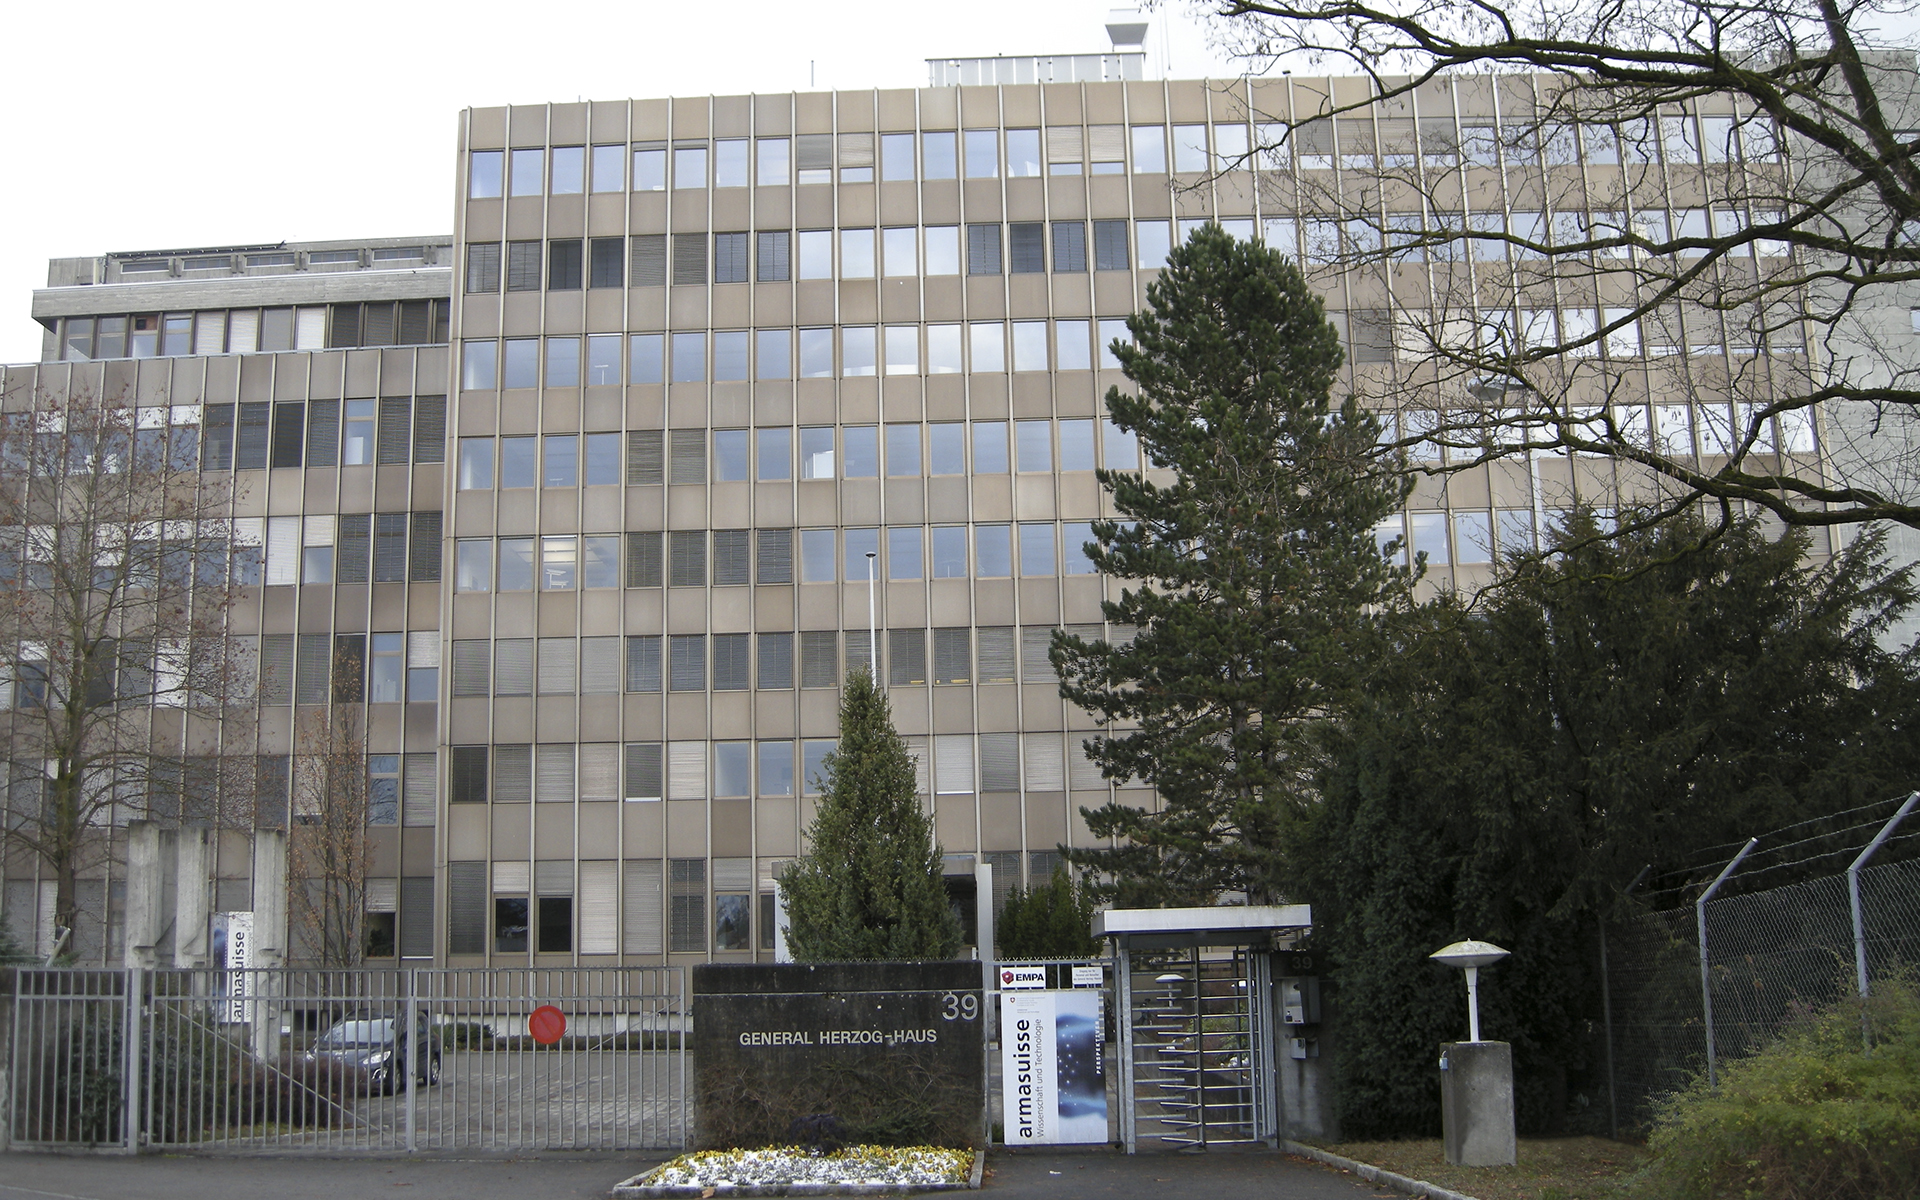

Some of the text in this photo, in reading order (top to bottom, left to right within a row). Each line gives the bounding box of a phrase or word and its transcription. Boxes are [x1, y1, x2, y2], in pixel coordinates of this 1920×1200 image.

[1292, 956, 1312, 969] 39
[1016, 973, 1044, 981] EMPA
[941, 994, 979, 1021] 39
[739, 1029, 937, 1045] GENERAL HERZOG-HAUS
[1013, 1019, 1032, 1138] armasuisse
[1035, 1019, 1044, 1138] Wissenschaft und Technologie
